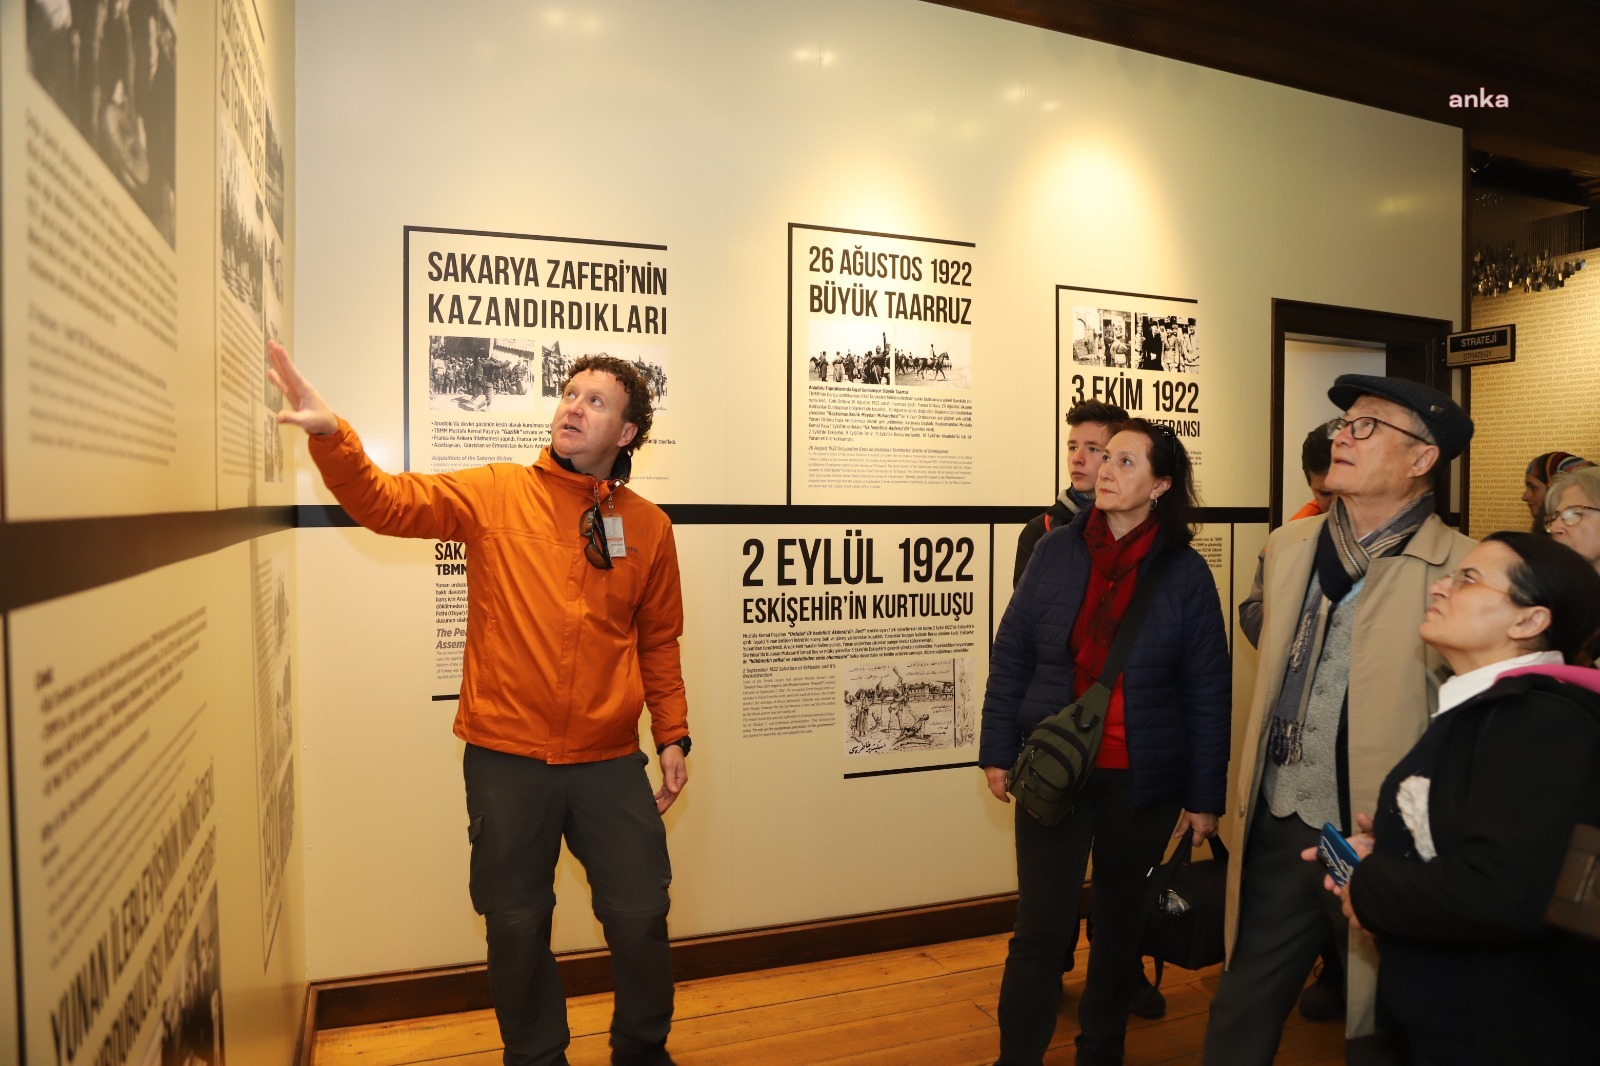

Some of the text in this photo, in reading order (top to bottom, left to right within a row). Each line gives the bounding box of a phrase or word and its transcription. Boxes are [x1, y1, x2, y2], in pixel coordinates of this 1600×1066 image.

[428, 251, 539, 287] SAKARYA
[809, 245, 972, 287] 26 AĞUSTOS 1922
[428, 293, 667, 335] KAZANDIRDIKLARI
[810, 280, 972, 325] BÜYÜK TAARRUZ
[1461, 332, 1497, 347] STRATEJİ
[1463, 351, 1493, 360] STRATEGY
[1071, 372, 1198, 413] 3 EKİM 1922
[1147, 418, 1200, 438] RANSI
[435, 543, 467, 560] SAK
[742, 529, 975, 587] 2 EYLÜL 1922
[873, 591, 974, 621] KURTULUŞU
[437, 628, 452, 637] The
[51, 931, 110, 1066] YUNAN
